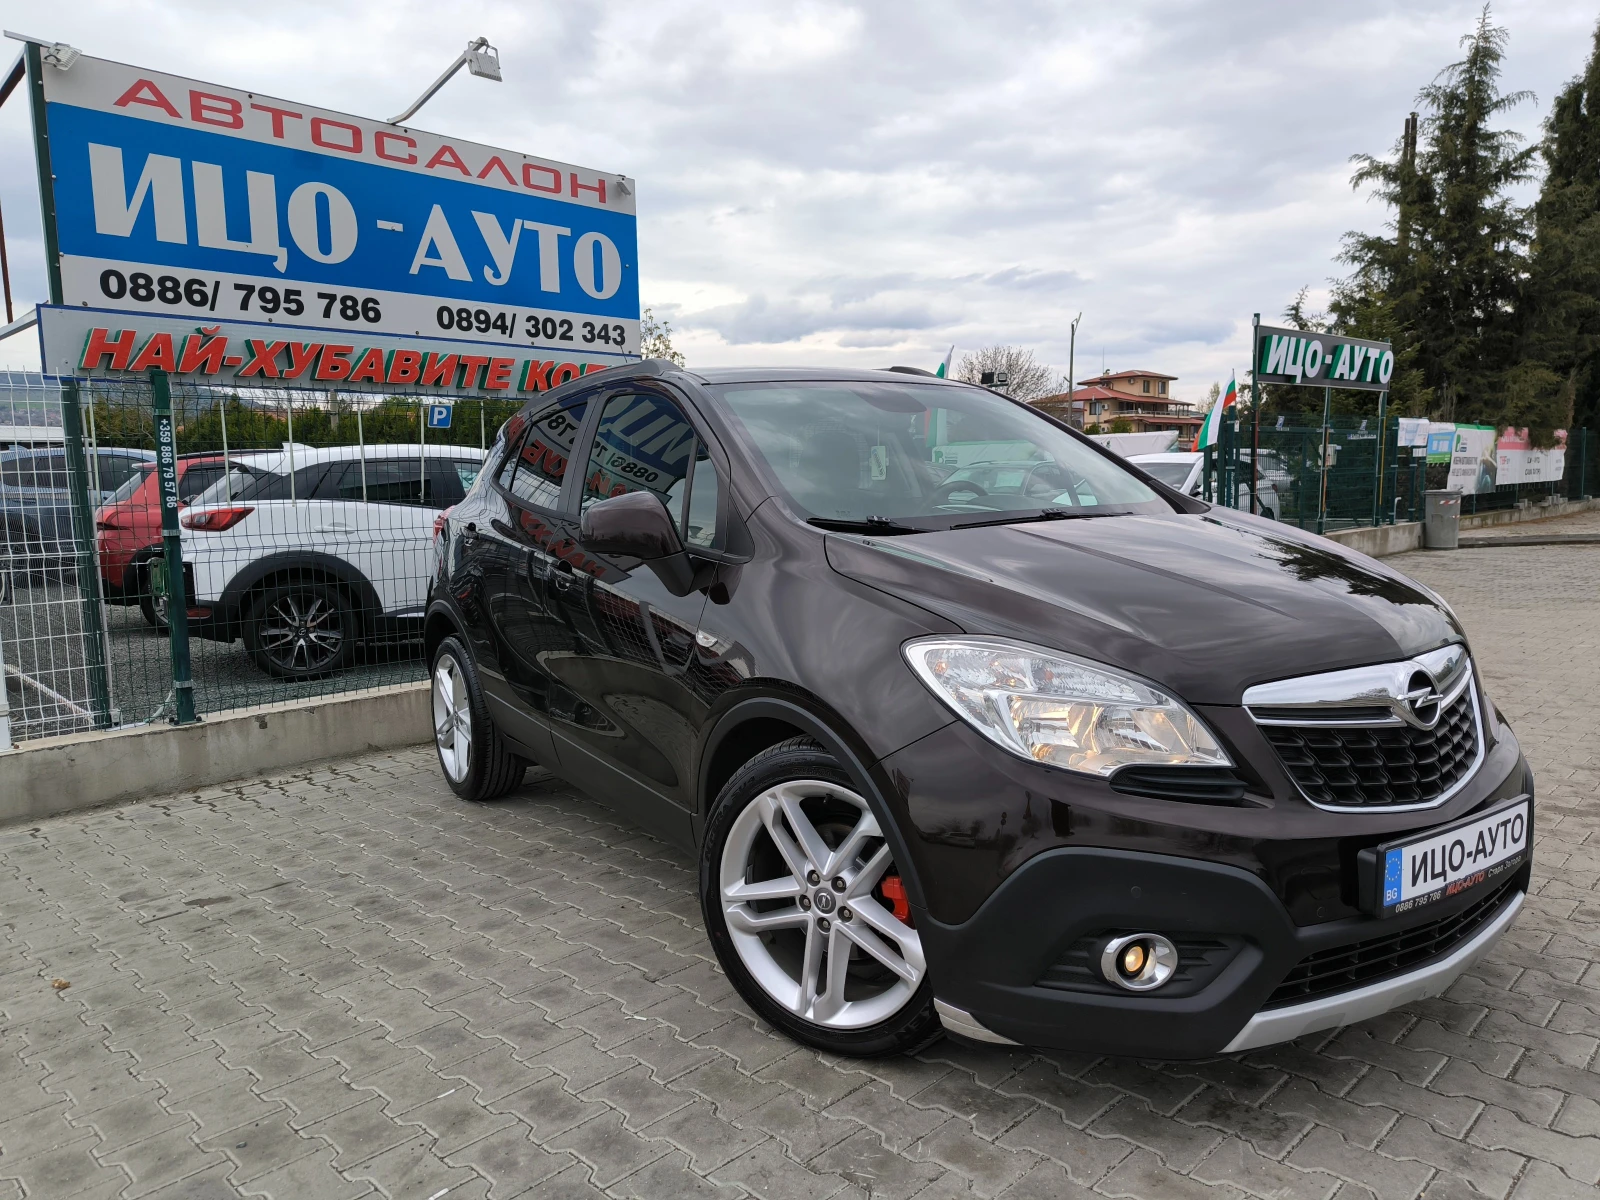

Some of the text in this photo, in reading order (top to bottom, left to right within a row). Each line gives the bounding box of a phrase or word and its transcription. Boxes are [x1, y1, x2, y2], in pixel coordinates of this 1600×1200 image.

[113, 79, 606, 203] АВТОСАЛОН
[100, 269, 382, 323] 0886/ 795 786
[436, 305, 626, 346] 0894/ 302 343
[80, 325, 515, 389] НАЙ-ХУБАВИТЕ
[1266, 334, 1394, 384] ИЦО-АУТО
[160, 418, 177, 508] +359 886 79 57 86
[1411, 813, 1524, 887] ИЦО-АУТО
[1386, 888, 1397, 901] BG
[1395, 890, 1442, 913] 0886 795 786
